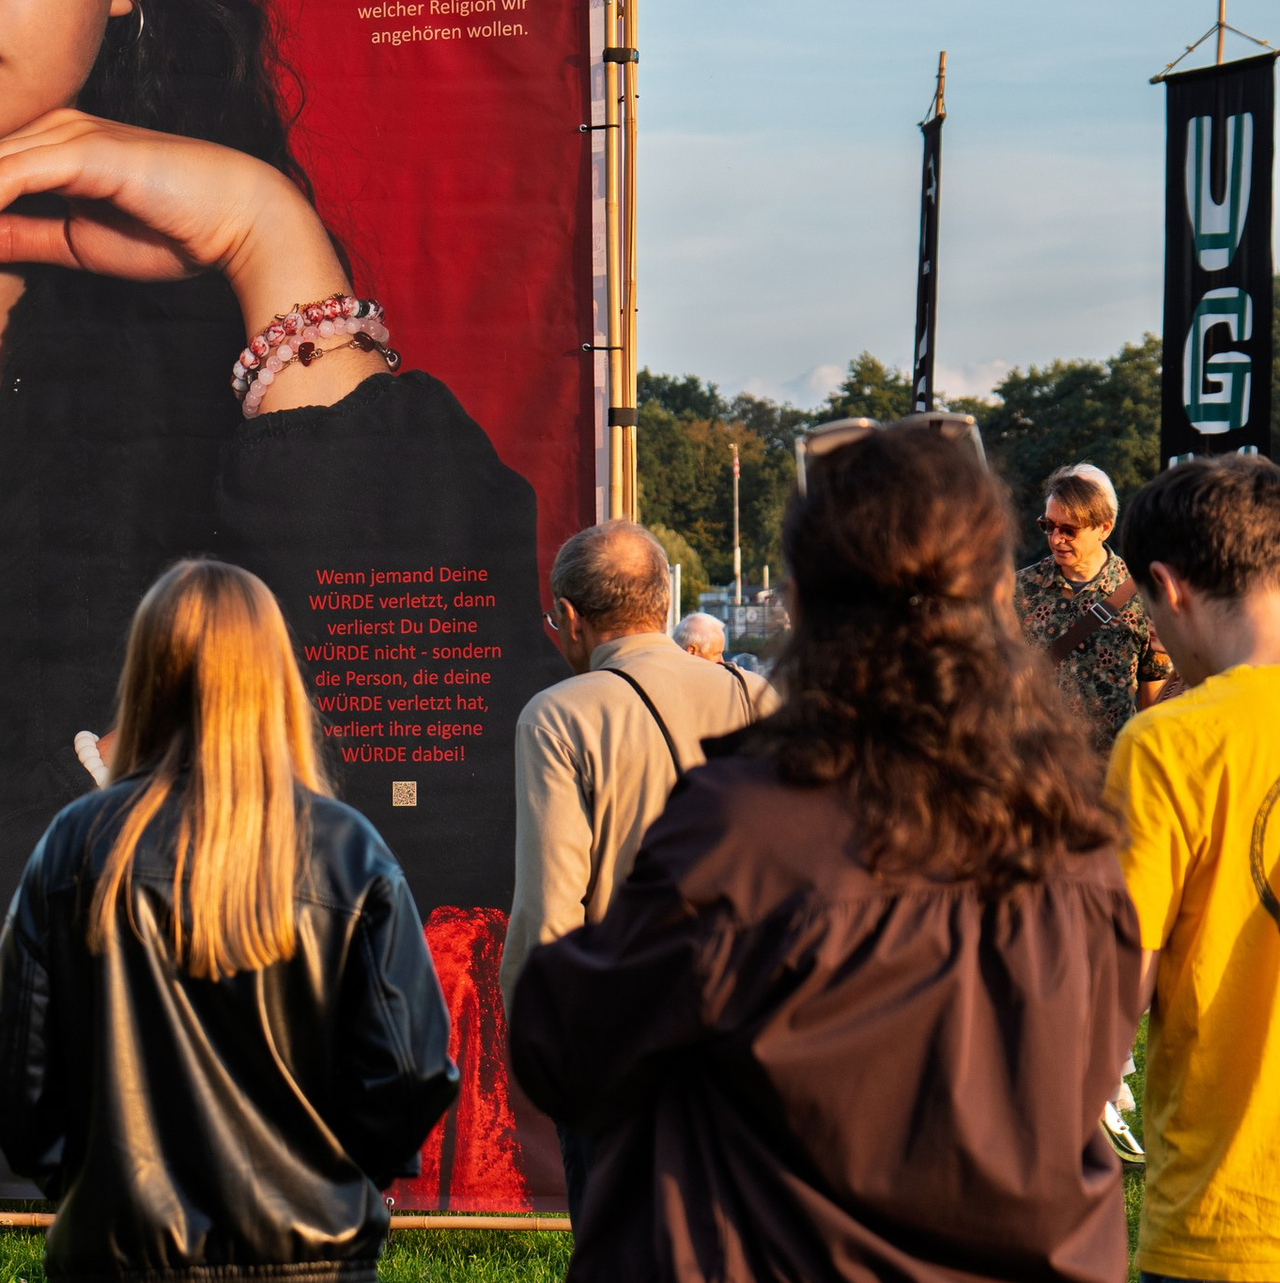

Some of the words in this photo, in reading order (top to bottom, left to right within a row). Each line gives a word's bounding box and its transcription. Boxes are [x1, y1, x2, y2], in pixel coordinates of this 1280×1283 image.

[357, 1, 425, 19] welcher
[371, 25, 462, 46] angehören
[466, 20, 528, 38] wollen.
[315, 569, 366, 586] Wenn
[369, 566, 434, 588] jemand
[439, 566, 489, 583] Deine
[308, 591, 374, 611] WÜRDE
[378, 592, 448, 611] verletzt,
[452, 591, 496, 608] dann
[326, 619, 395, 636] verlierst
[400, 618, 424, 635] Du
[428, 617, 478, 634] Deine
[304, 642, 369, 662] WÜRDE
[374, 643, 416, 661] nicht
[432, 642, 502, 660] sondern
[315, 670, 341, 687] die
[345, 670, 408, 688] Person,
[412, 668, 439, 686] die
[443, 668, 491, 686] deine
[317, 693, 383, 713] WÜRDE
[387, 694, 452, 712] verletzt
[456, 693, 489, 712] hat,
[323, 720, 385, 738] verliert
[388, 720, 422, 737] ihre
[426, 720, 483, 740] eigene
[341, 743, 406, 763] WÜRDE
[411, 745, 465, 763] dabei!
